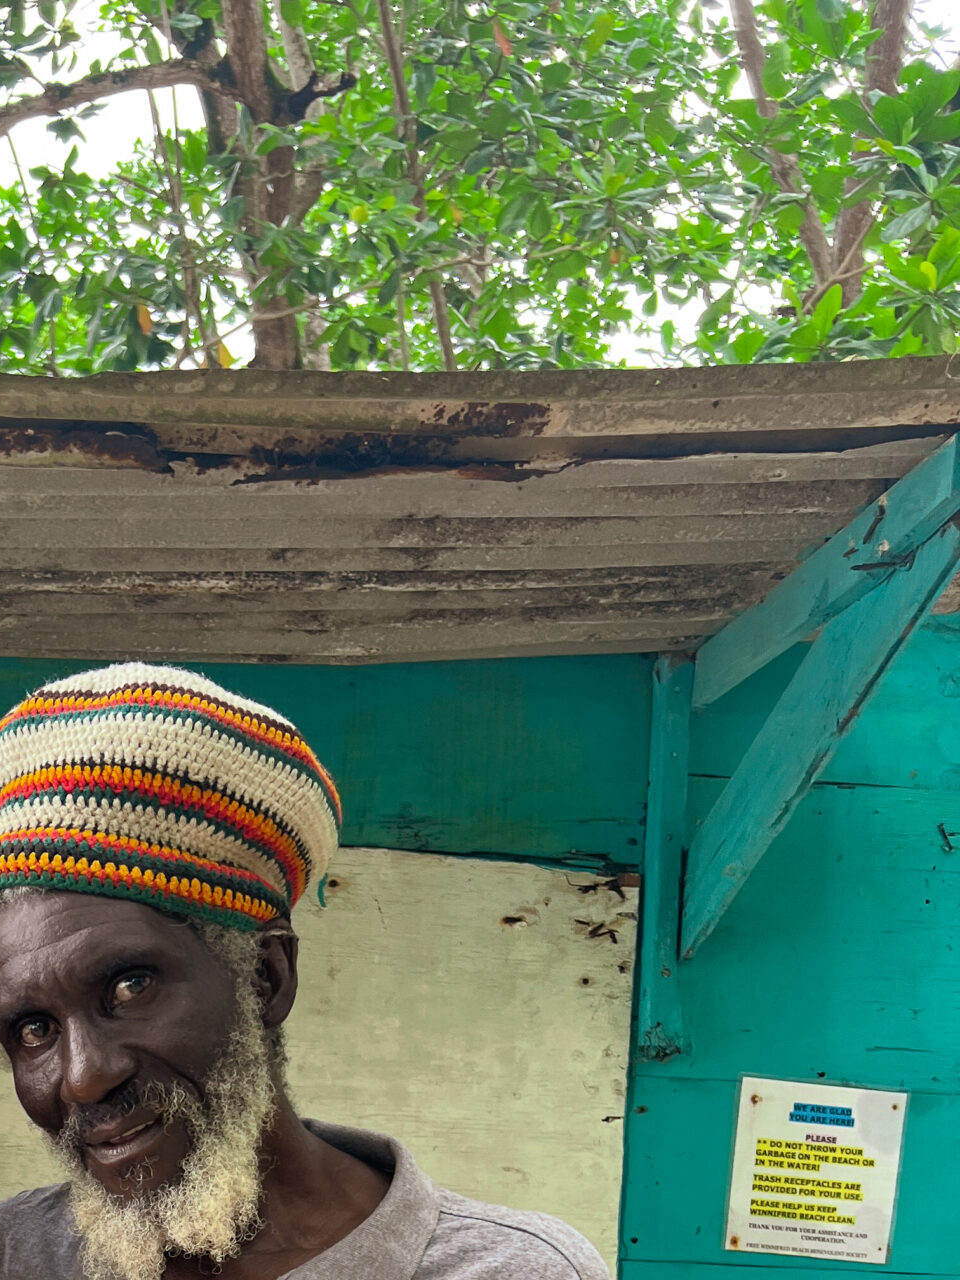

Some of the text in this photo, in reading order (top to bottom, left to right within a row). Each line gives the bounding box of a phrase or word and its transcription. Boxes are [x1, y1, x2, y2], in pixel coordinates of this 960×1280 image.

[794, 1104, 806, 1112] WE
[830, 1108, 852, 1116] GLAD
[830, 1118, 854, 1127] HERE!
[806, 1135, 837, 1143] PLEASE
[806, 1144, 837, 1153] THROW
[840, 1147, 863, 1156] YOUR
[756, 1150, 796, 1159] GARBAGE
[832, 1157, 860, 1165] BEACH
[787, 1162, 819, 1171] WATER!
[785, 1177, 841, 1188] RECEPTACLES
[752, 1184, 796, 1194] PROVIDED
[750, 1208, 796, 1219] WINNIFRED
[828, 1216, 854, 1224] CLEAN.
